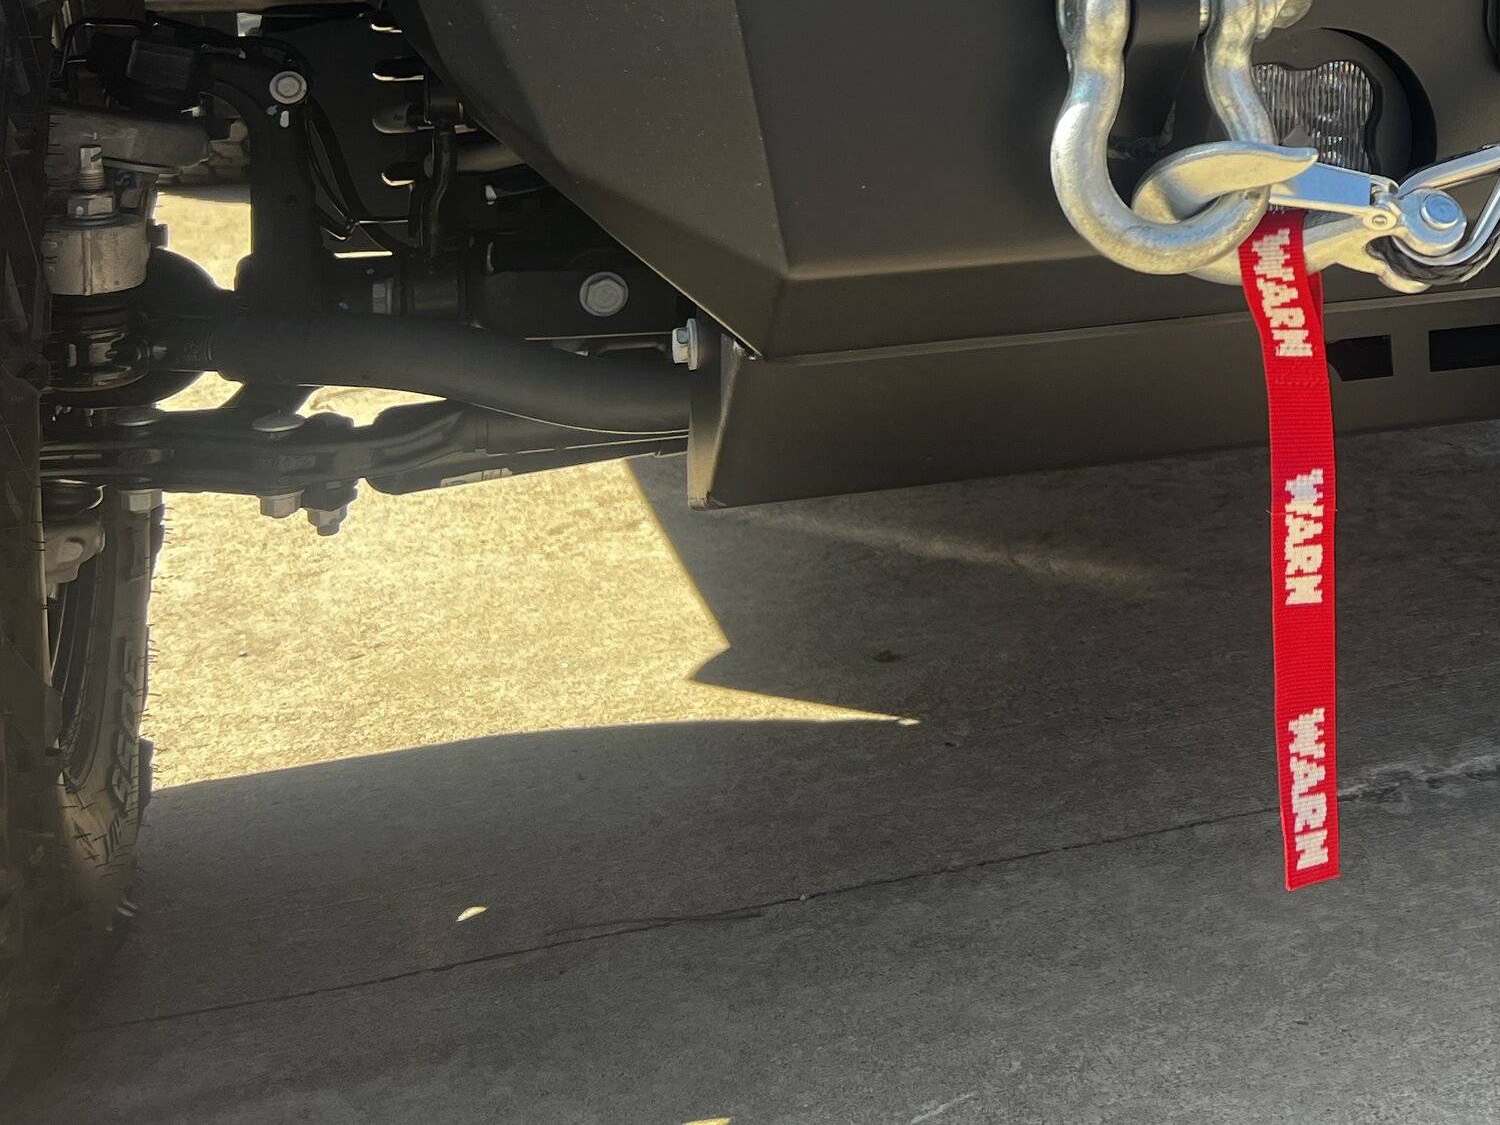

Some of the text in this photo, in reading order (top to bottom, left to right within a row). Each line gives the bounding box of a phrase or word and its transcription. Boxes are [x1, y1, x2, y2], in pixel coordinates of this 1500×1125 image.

[1252, 227, 1313, 357] WARN
[1285, 468, 1323, 606] WARN
[1288, 707, 1328, 870] WARN
